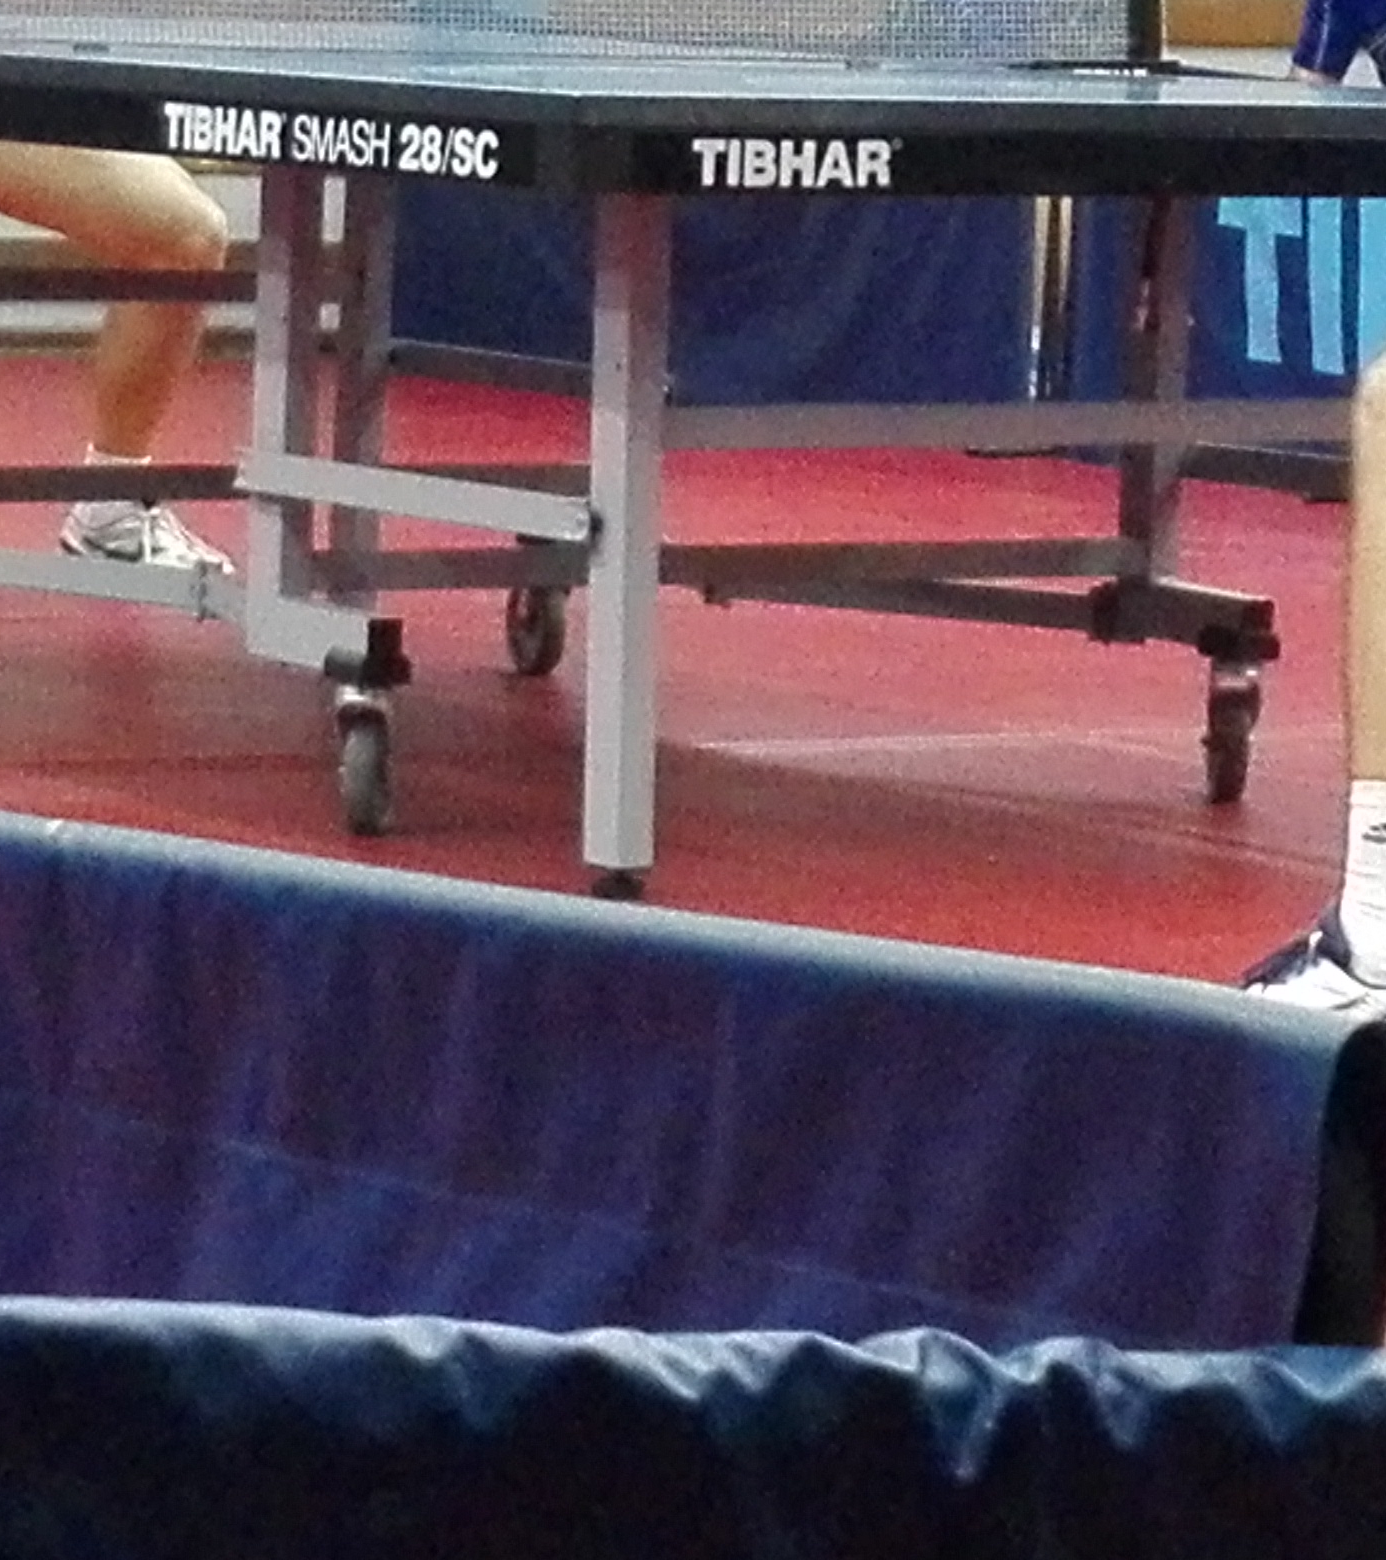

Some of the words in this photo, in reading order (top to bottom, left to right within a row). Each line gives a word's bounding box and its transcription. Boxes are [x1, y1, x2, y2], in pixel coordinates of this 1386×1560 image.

[163, 101, 282, 160] TIBHAR
[291, 113, 392, 168] SMASH
[398, 123, 500, 180] 28/SC
[692, 138, 893, 188] TIBHAR
